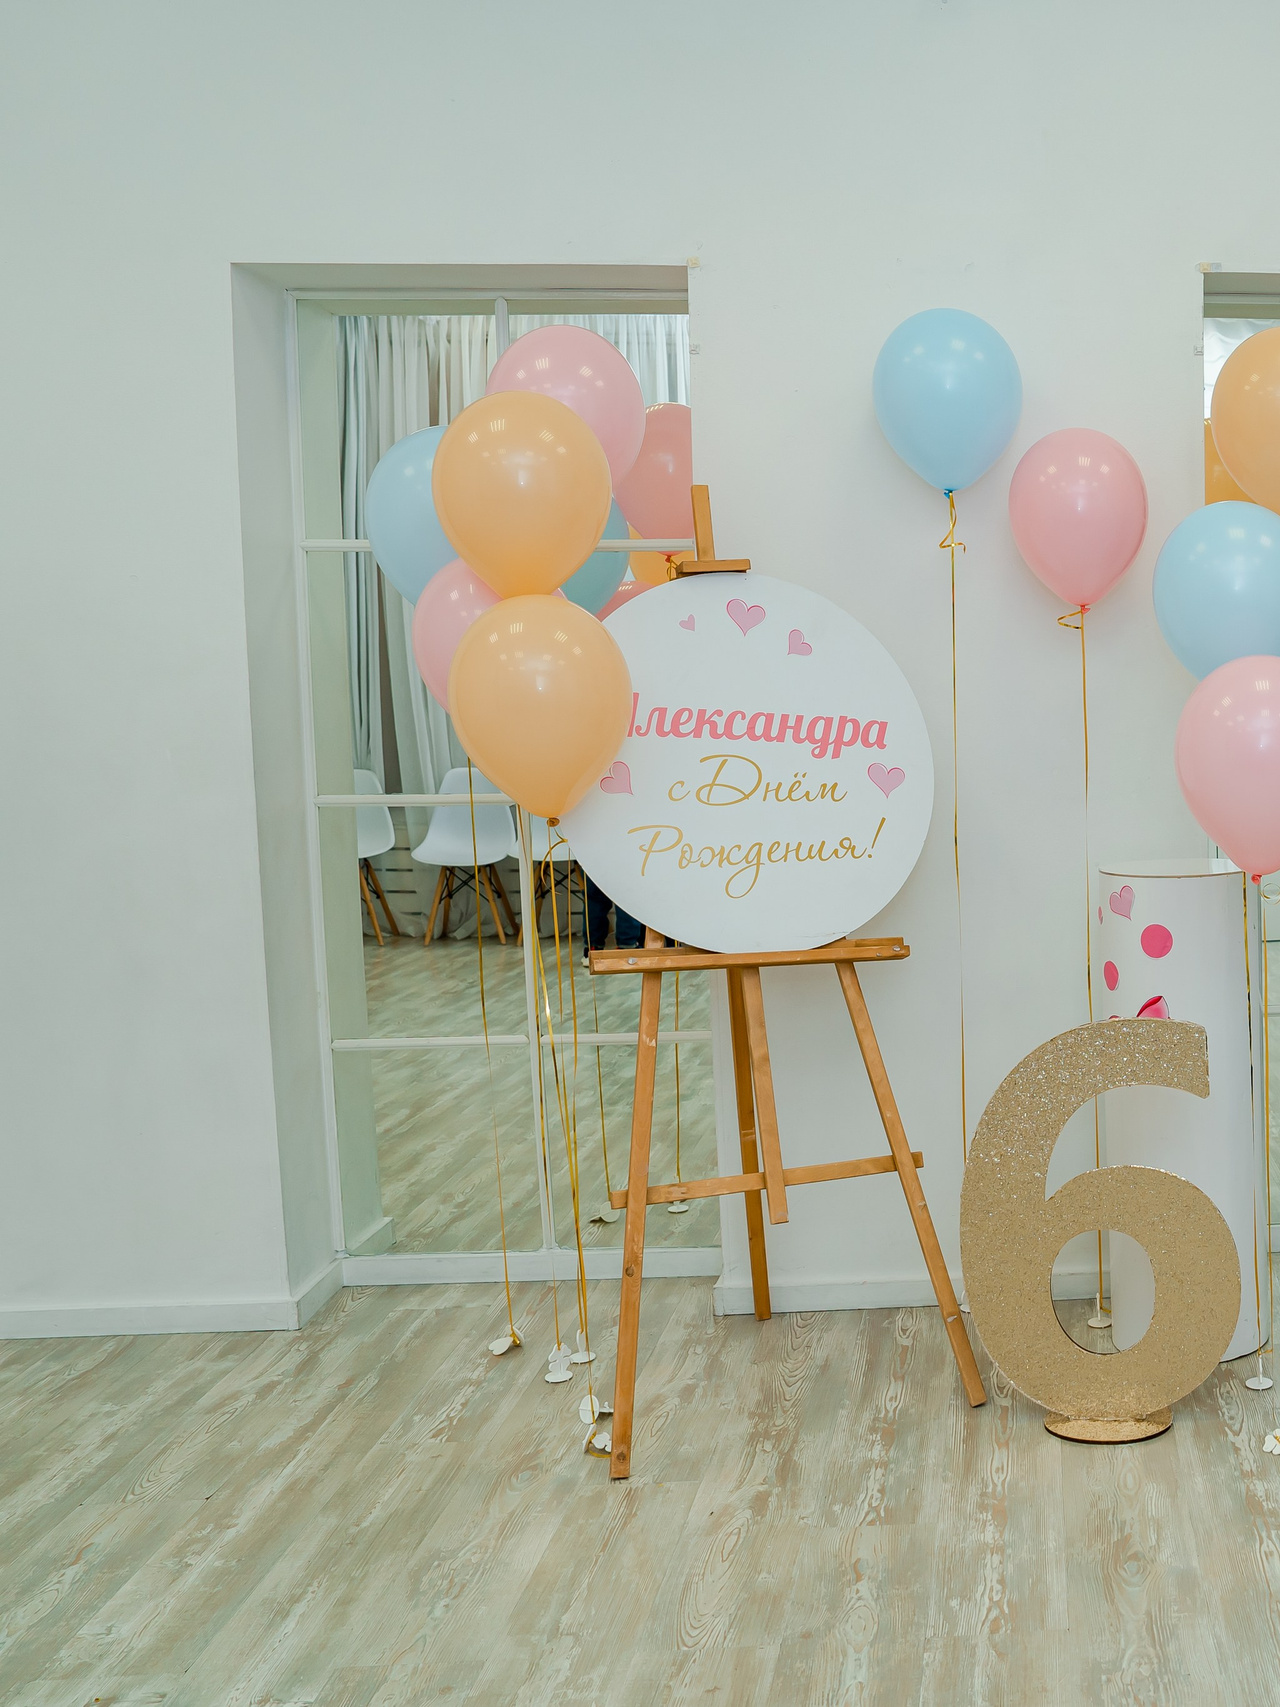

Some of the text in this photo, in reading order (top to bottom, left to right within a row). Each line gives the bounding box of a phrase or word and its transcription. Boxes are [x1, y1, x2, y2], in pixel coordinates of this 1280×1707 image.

[668, 754, 847, 806] с Днём
[627, 817, 886, 899] Рождения!
[961, 1018, 1241, 1421] 6
